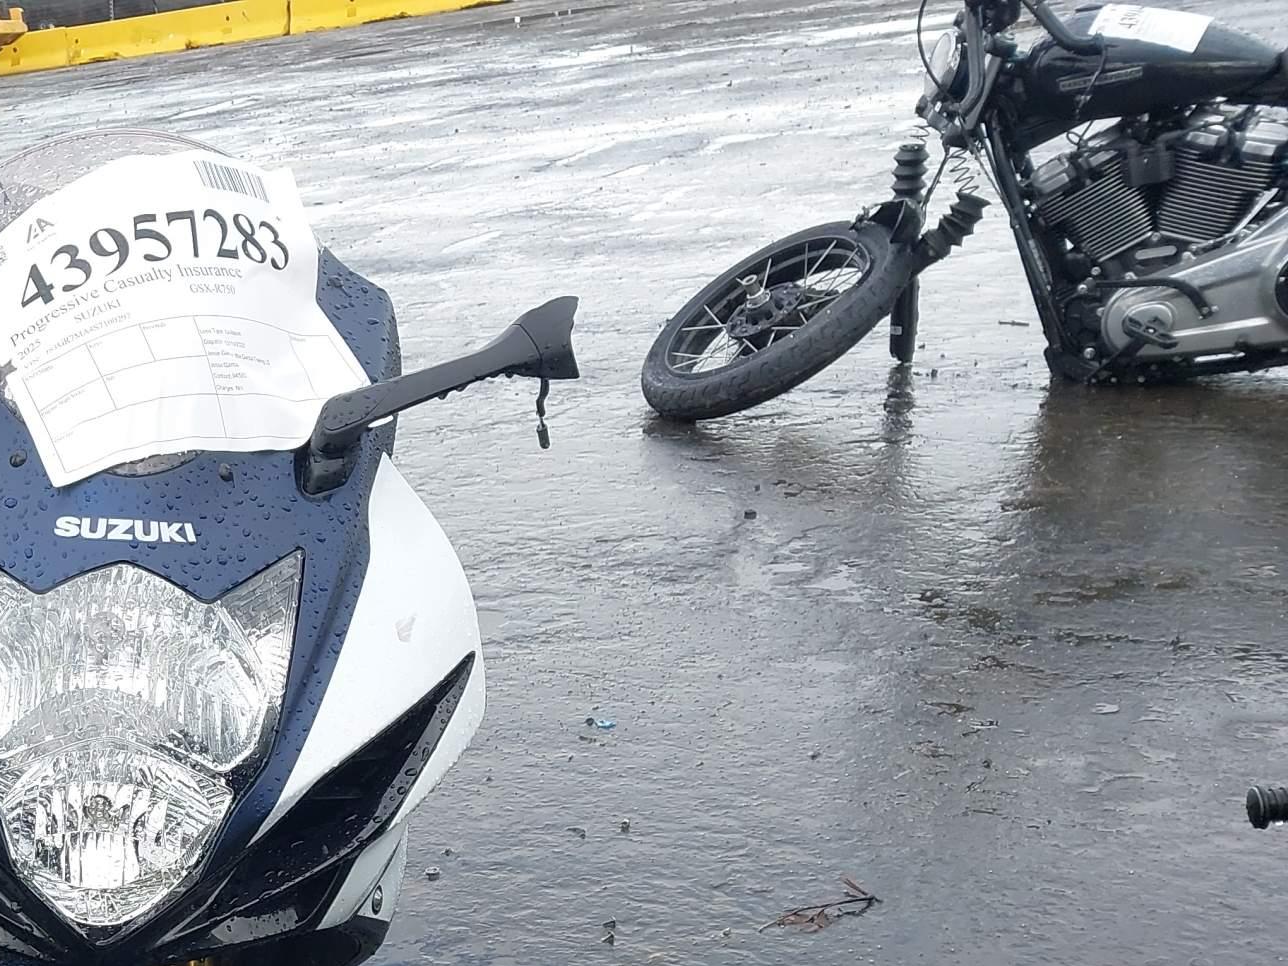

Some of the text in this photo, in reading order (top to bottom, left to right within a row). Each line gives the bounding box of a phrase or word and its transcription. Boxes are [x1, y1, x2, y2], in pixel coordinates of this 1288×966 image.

[20, 208, 290, 309] 43957283
[10, 263, 243, 347] Progressive Casualty Insurance
[16, 282, 237, 361] 2025 SUZUKI GSX-R750
[53, 516, 198, 544] SUZUKI
